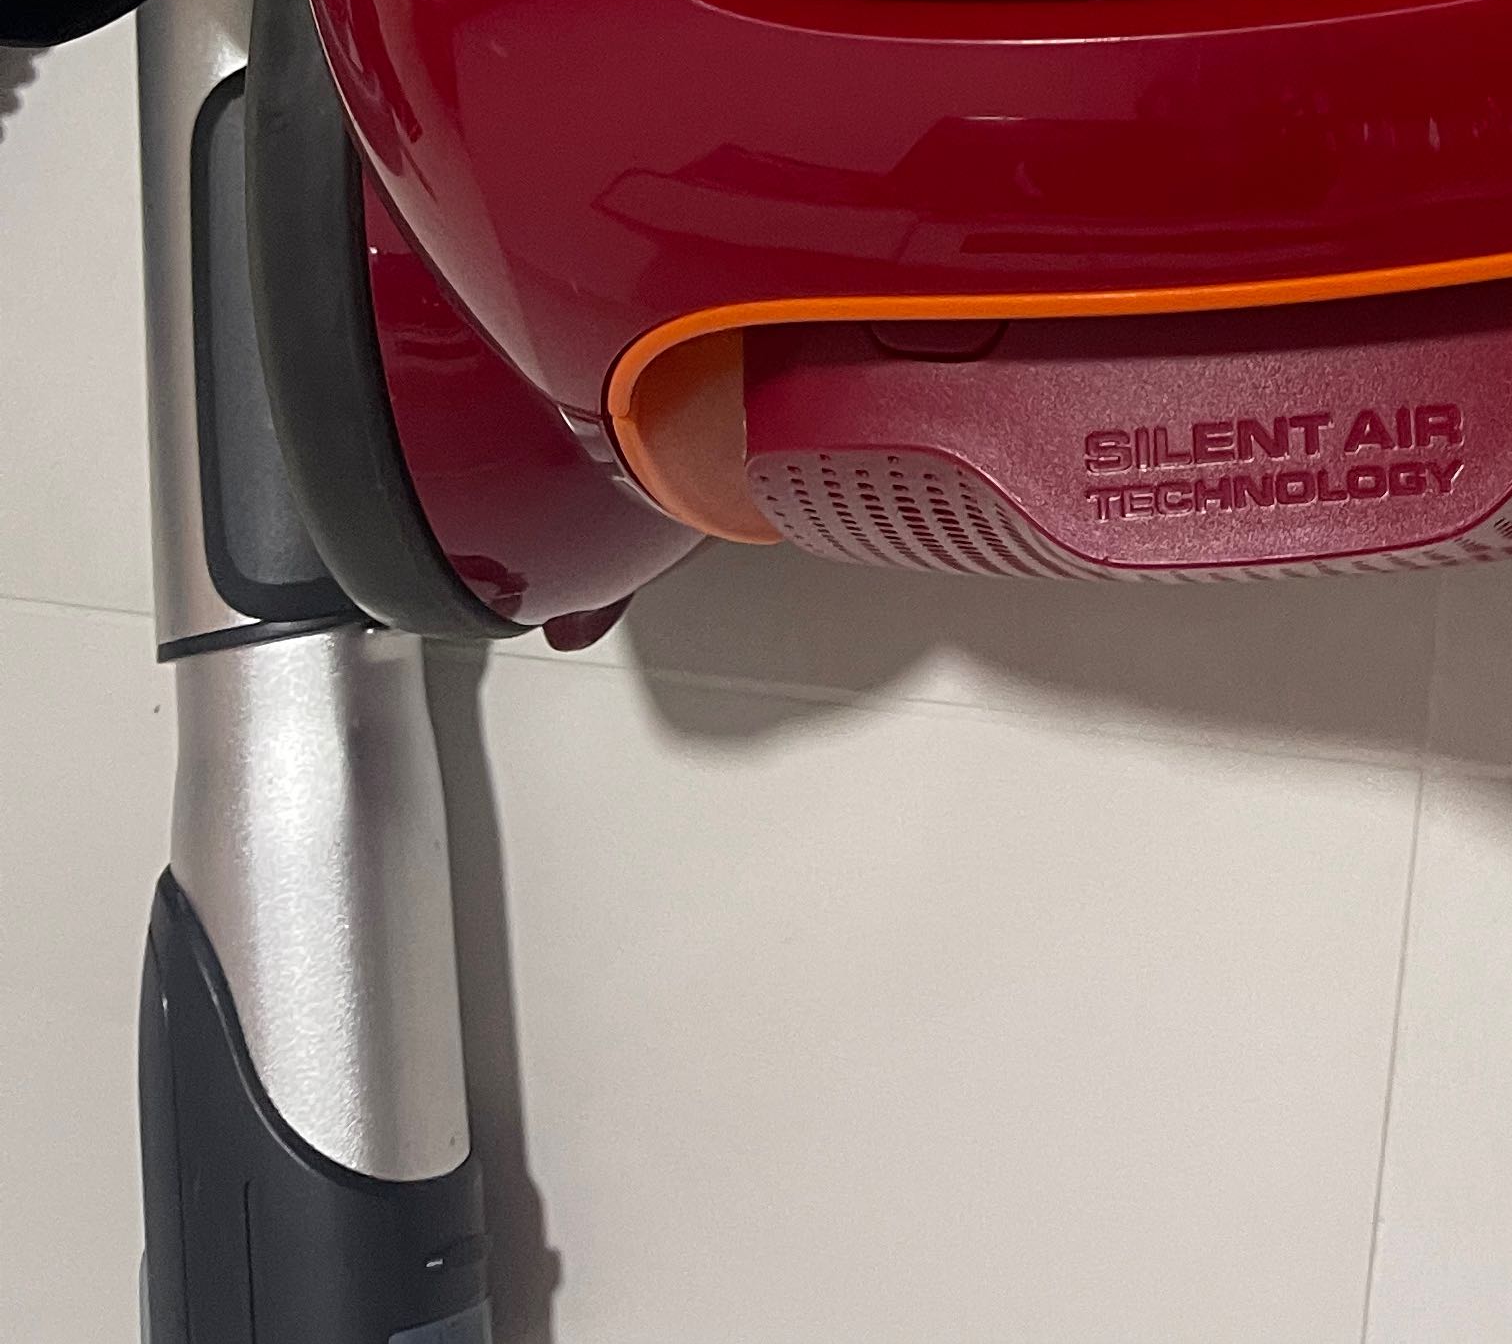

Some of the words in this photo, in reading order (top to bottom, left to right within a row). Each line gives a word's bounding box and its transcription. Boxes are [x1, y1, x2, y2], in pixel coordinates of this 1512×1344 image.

[1083, 411, 1335, 476] SILENT
[1342, 403, 1466, 456] AIR
[1085, 459, 1466, 524] TECHNOLOGY
